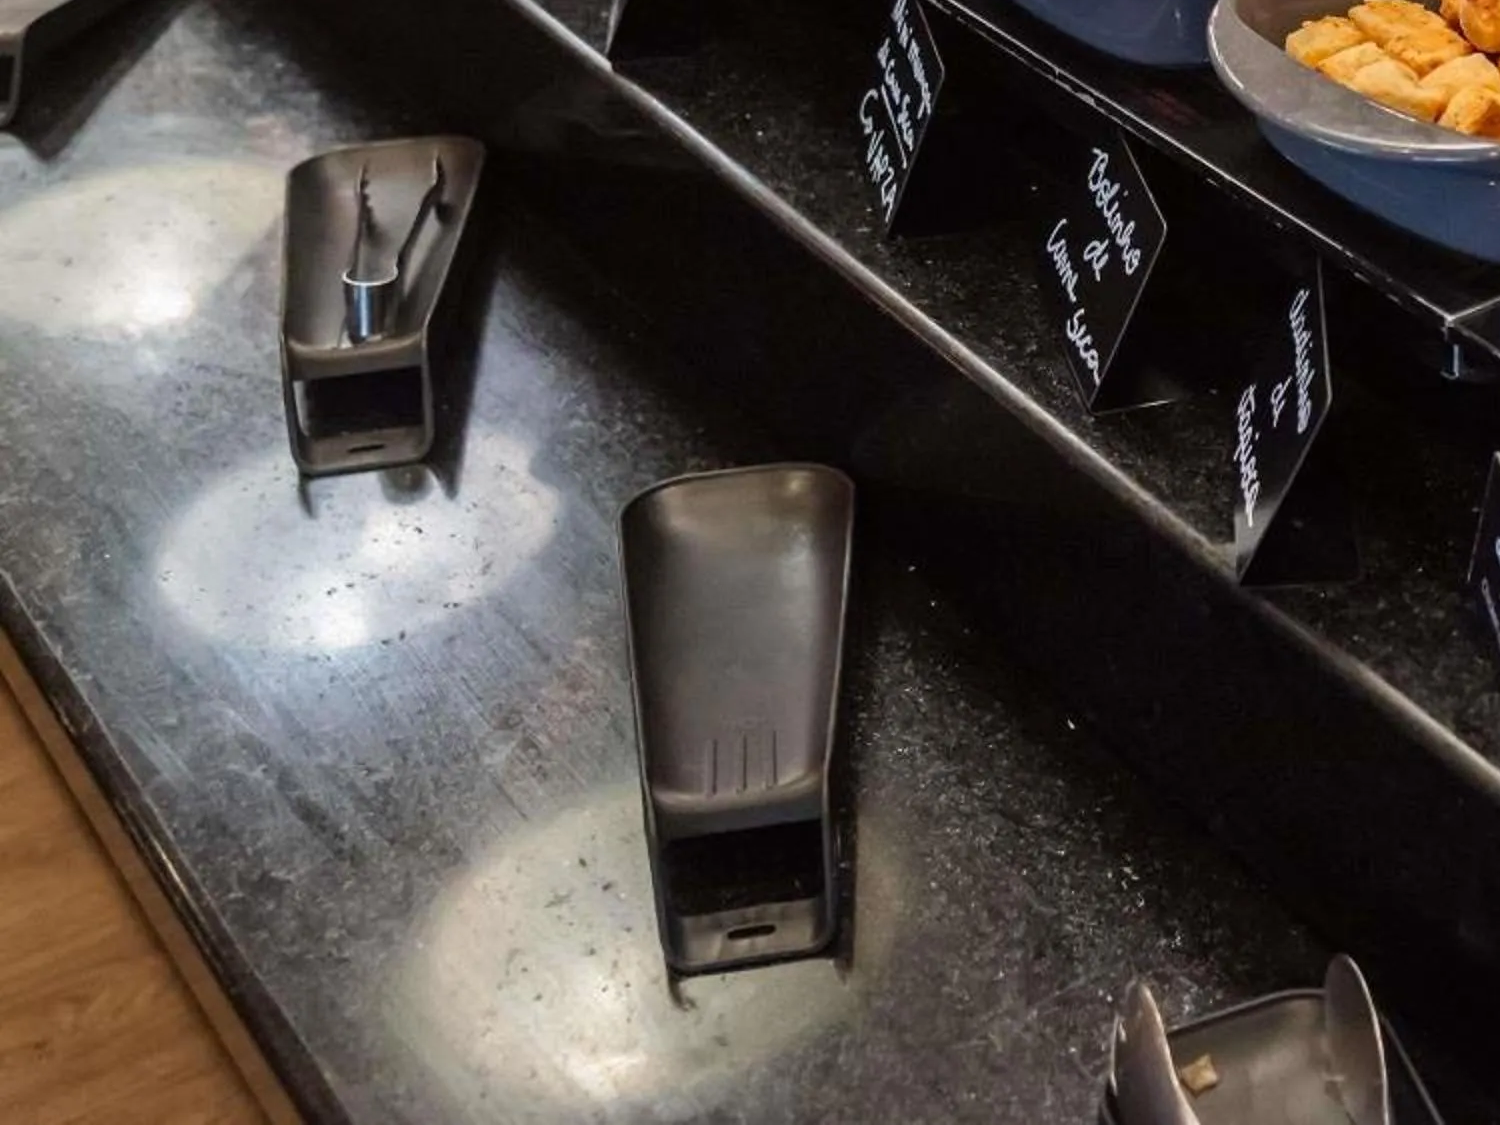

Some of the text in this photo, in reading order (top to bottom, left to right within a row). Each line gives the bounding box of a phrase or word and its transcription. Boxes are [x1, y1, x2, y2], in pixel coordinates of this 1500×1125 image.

[865, 128, 898, 224] VAPZA
[1087, 146, 1142, 276] Bolinho
[1082, 238, 1110, 283] de
